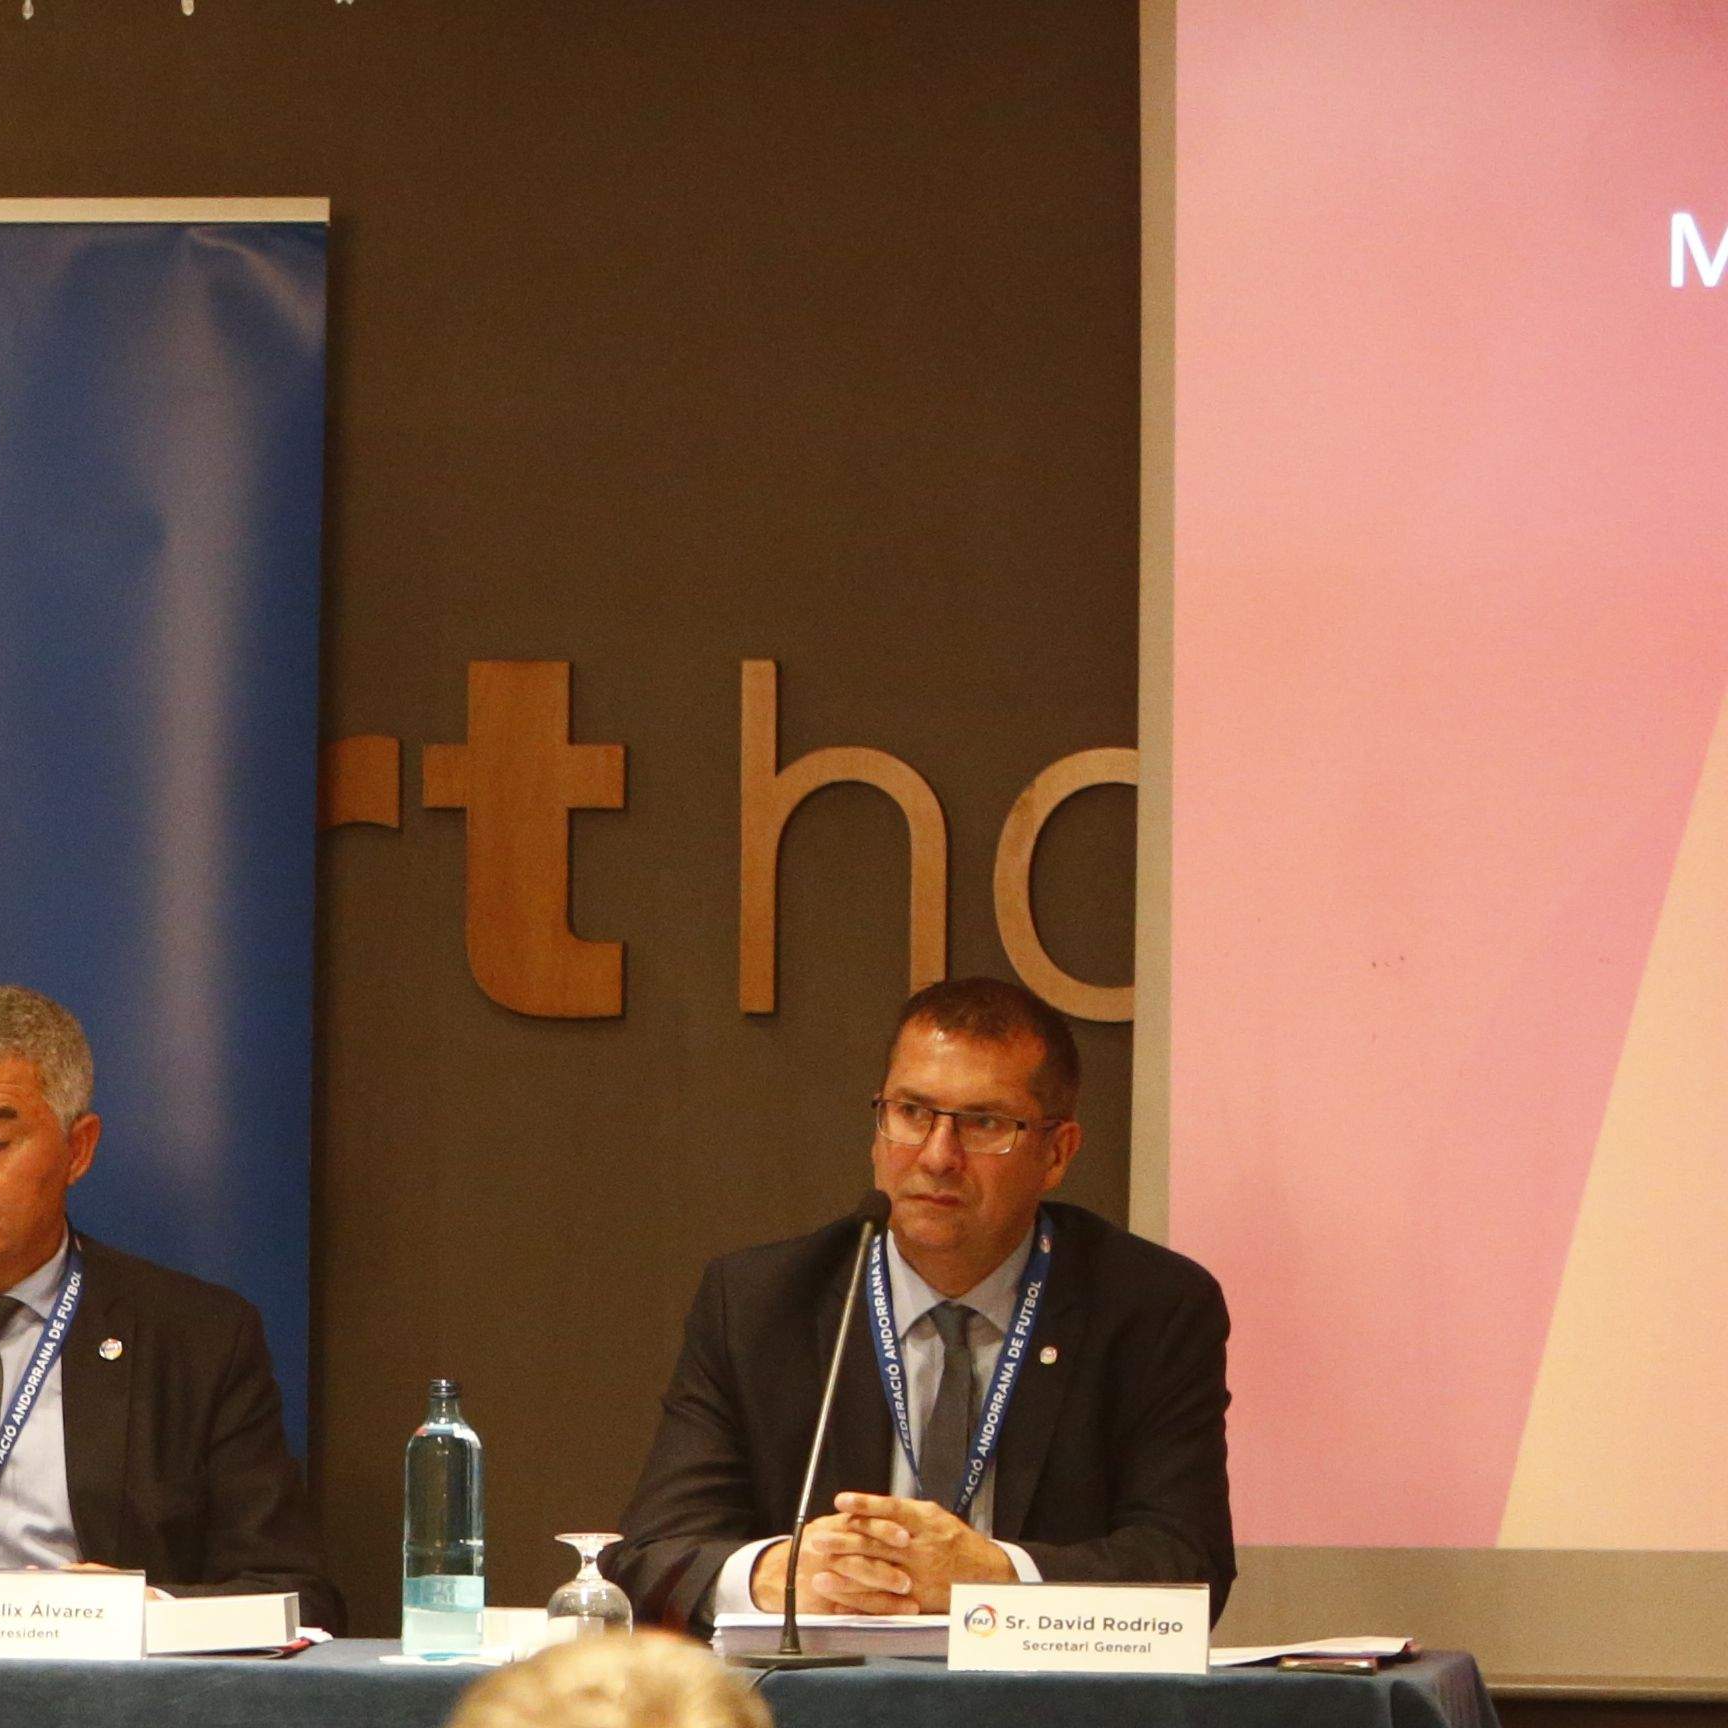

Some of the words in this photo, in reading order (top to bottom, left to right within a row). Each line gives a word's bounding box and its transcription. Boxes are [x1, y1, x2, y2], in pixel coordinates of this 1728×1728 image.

[56, 1269, 84, 1318] FUTBOL
[870, 1270, 899, 1360] ANDORRANA
[1015, 1280, 1043, 1337] FUTBOL
[48, 1318, 69, 1342] DE
[1010, 1336, 1024, 1360] DE
[10, 1342, 57, 1427] ANDORRANA
[888, 1362, 912, 1450] FEDERACIÓ
[976, 1362, 1017, 1458] ANDORRANA
[30, 1600, 105, 1619] Álvarez
[1005, 1615, 1030, 1630] Sr.
[1038, 1615, 1095, 1631] David
[1102, 1616, 1184, 1636] Rodrigo
[1022, 1639, 1089, 1653] Secretari
[1094, 1641, 1152, 1654] General
